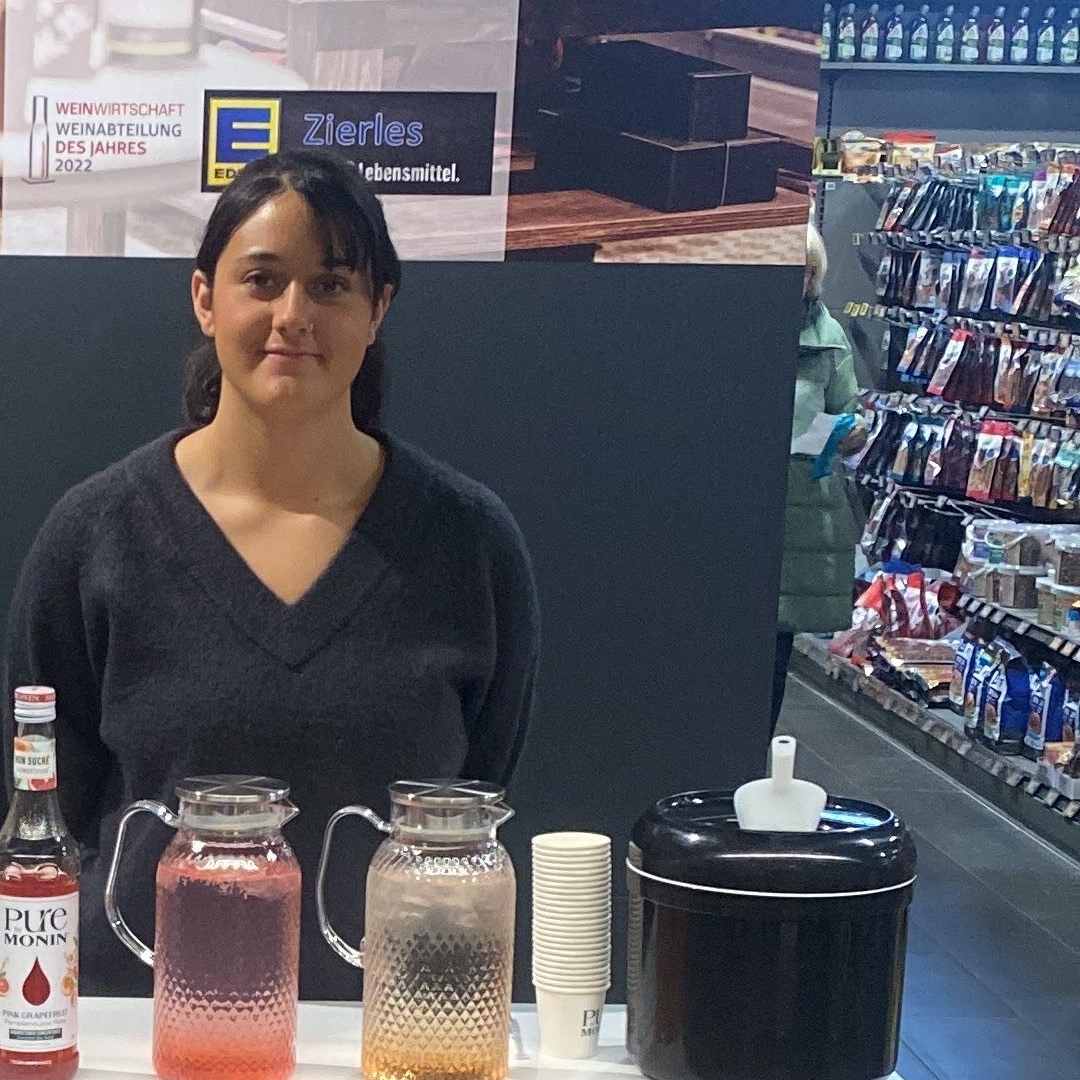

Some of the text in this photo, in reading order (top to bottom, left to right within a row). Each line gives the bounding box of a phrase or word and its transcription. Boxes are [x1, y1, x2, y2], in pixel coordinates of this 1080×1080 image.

[56, 102, 185, 116] WEINWIRTSCHAFT
[56, 122, 182, 137] WEINABTEILUNG
[303, 112, 424, 146] Zierles
[56, 141, 147, 157] DES JAHRES
[55, 159, 92, 172] 2022
[4, 933, 67, 947] MONIN
